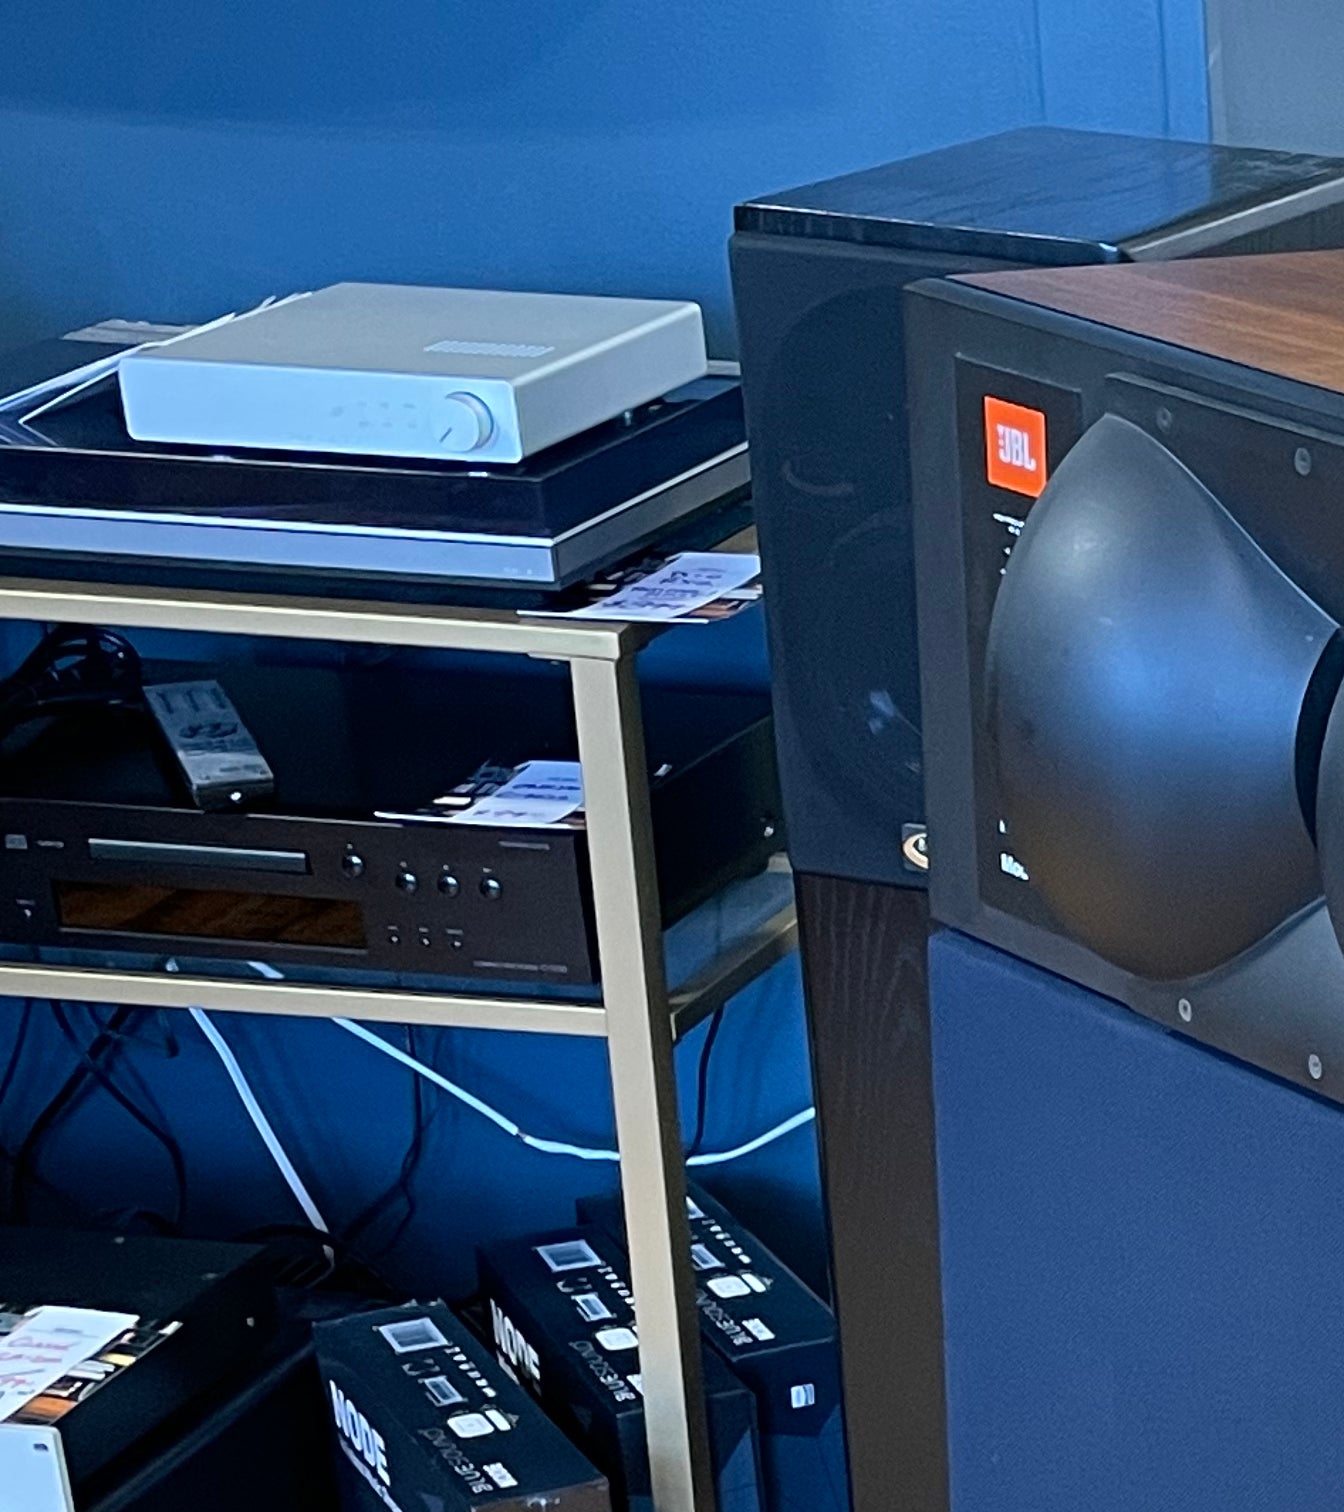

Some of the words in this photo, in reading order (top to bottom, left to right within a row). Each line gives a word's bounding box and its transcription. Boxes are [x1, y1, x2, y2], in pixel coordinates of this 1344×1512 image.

[996, 423, 1037, 472] JBL
[329, 1379, 391, 1487] NODE
[418, 1427, 494, 1494] BLUESOUND
